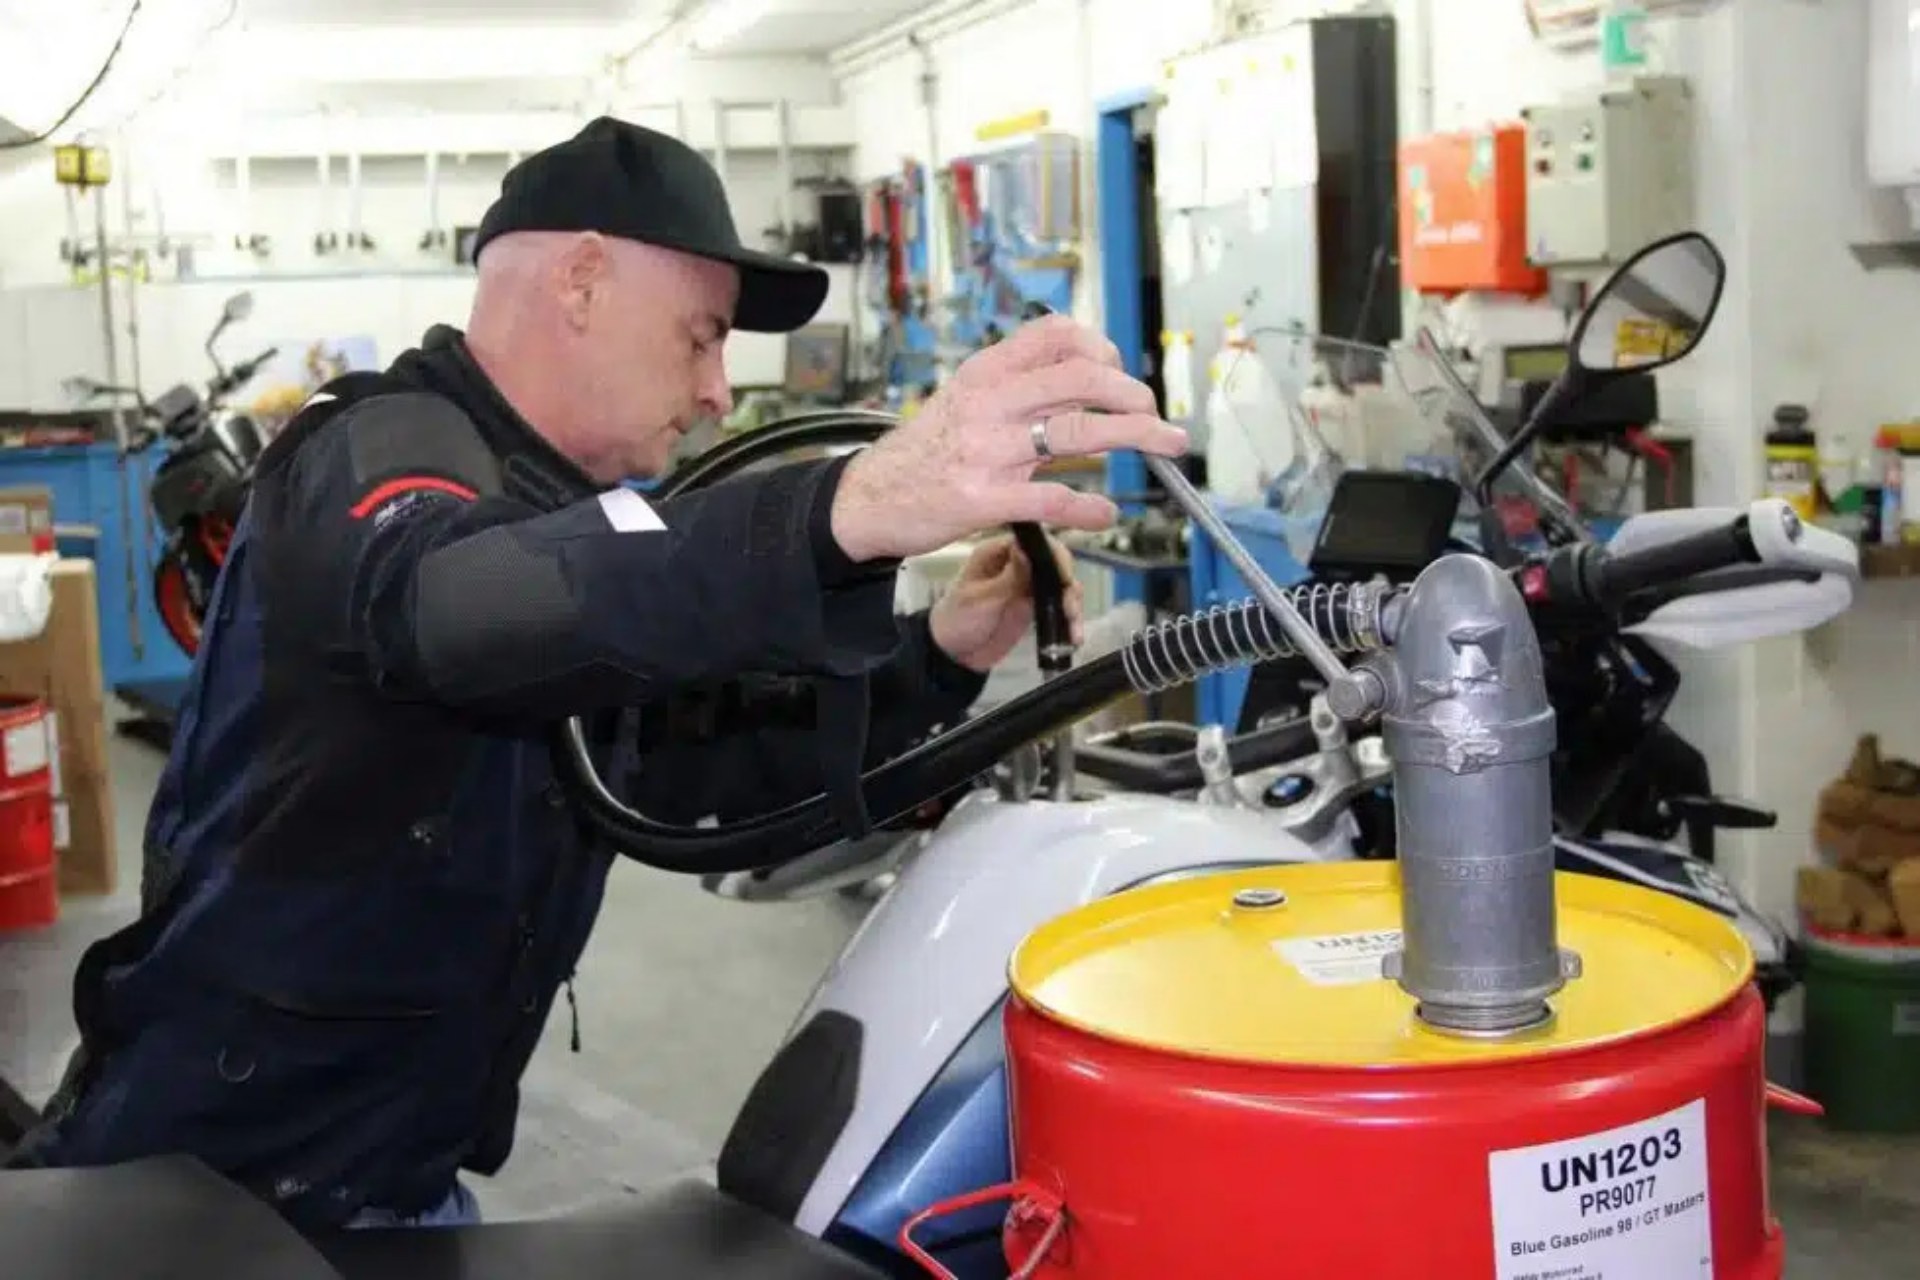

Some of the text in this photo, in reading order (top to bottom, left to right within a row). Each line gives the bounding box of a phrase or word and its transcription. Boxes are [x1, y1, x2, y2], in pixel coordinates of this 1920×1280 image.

[1541, 1127, 1682, 1192] UN1203
[1511, 1240, 1546, 1256] Blue
[1550, 1225, 1614, 1250] Gasoline
[1617, 1217, 1633, 1234] 98
[1643, 1208, 1660, 1226] GT
[1664, 1191, 1705, 1217] Masters
[1580, 1175, 1656, 1217] PR9077
